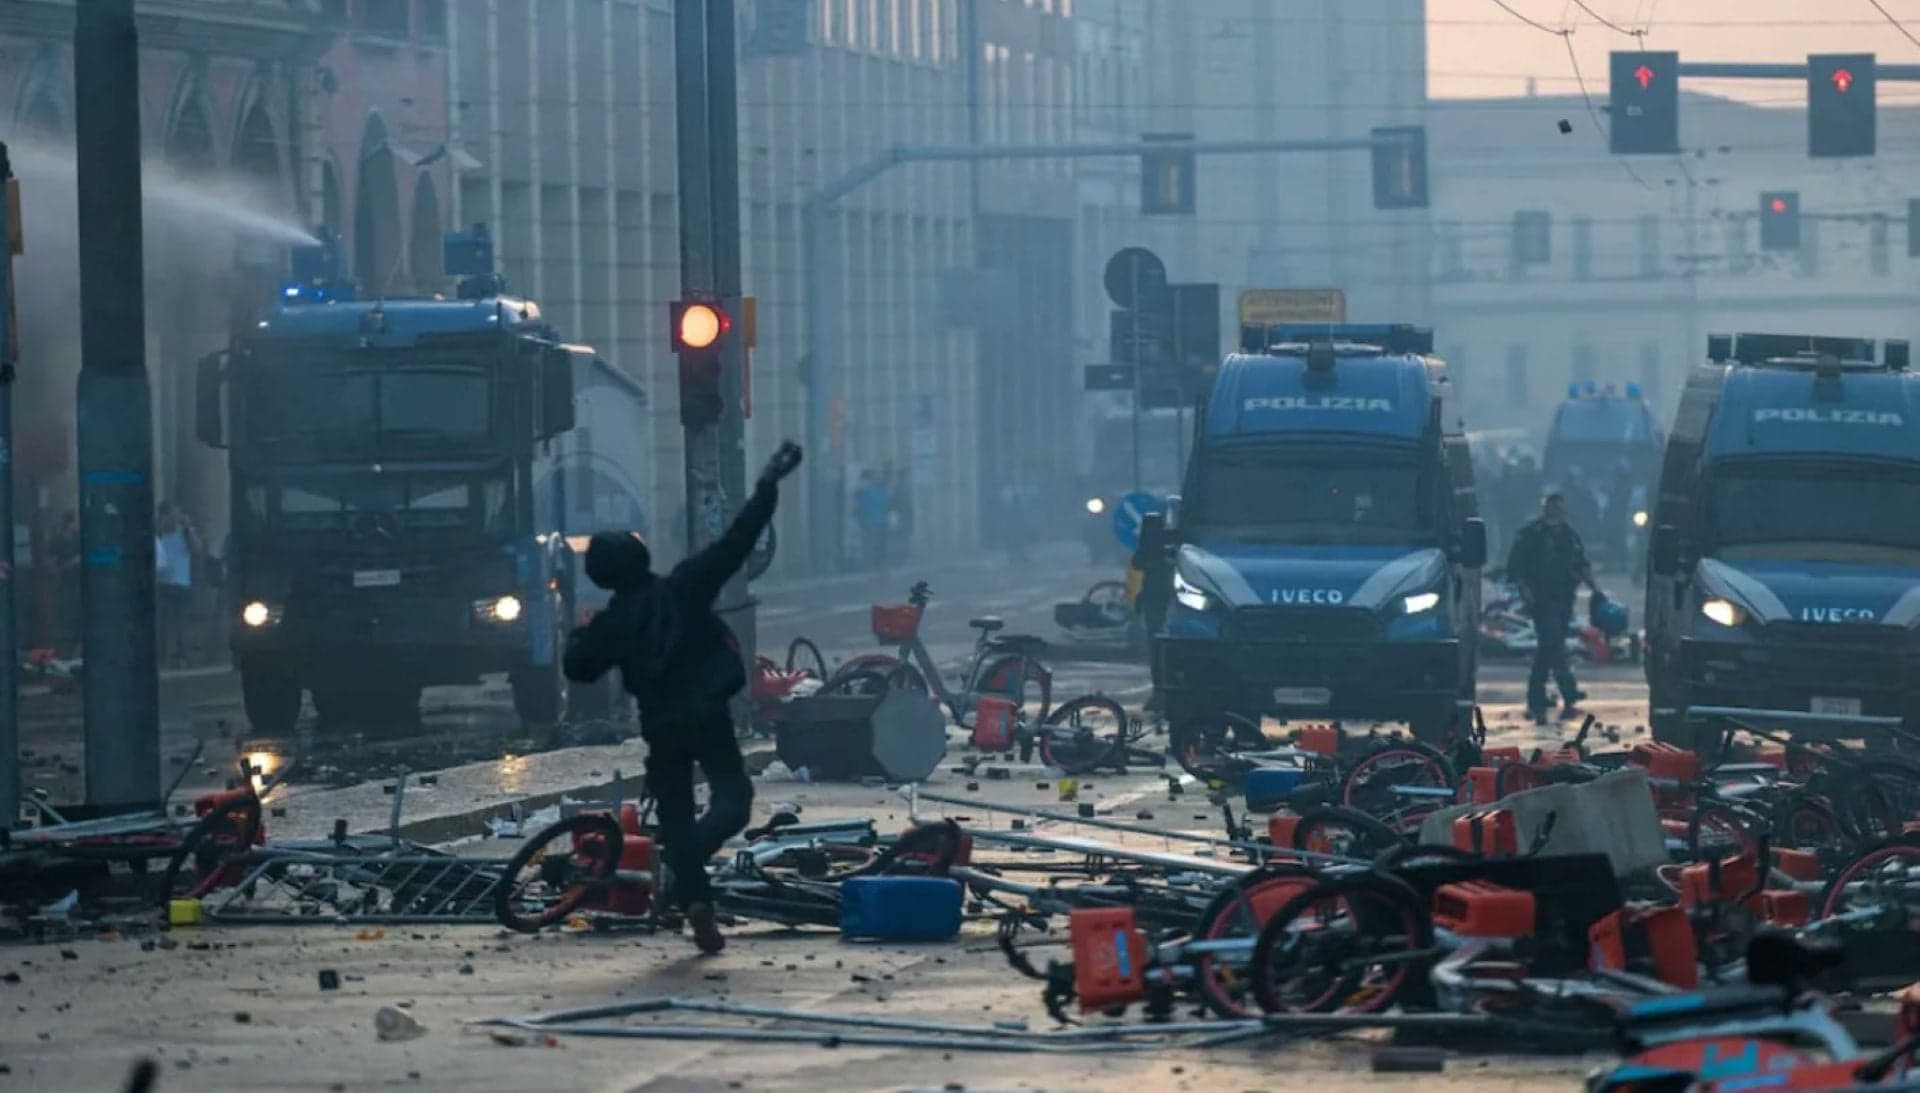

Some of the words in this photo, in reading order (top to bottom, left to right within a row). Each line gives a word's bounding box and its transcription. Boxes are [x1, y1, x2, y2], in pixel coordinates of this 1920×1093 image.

[1243, 397, 1391, 412] POLIZIA
[1755, 408, 1903, 426] POLIZIA
[1271, 588, 1343, 604] IVECO
[1802, 607, 1875, 622] IVECO
